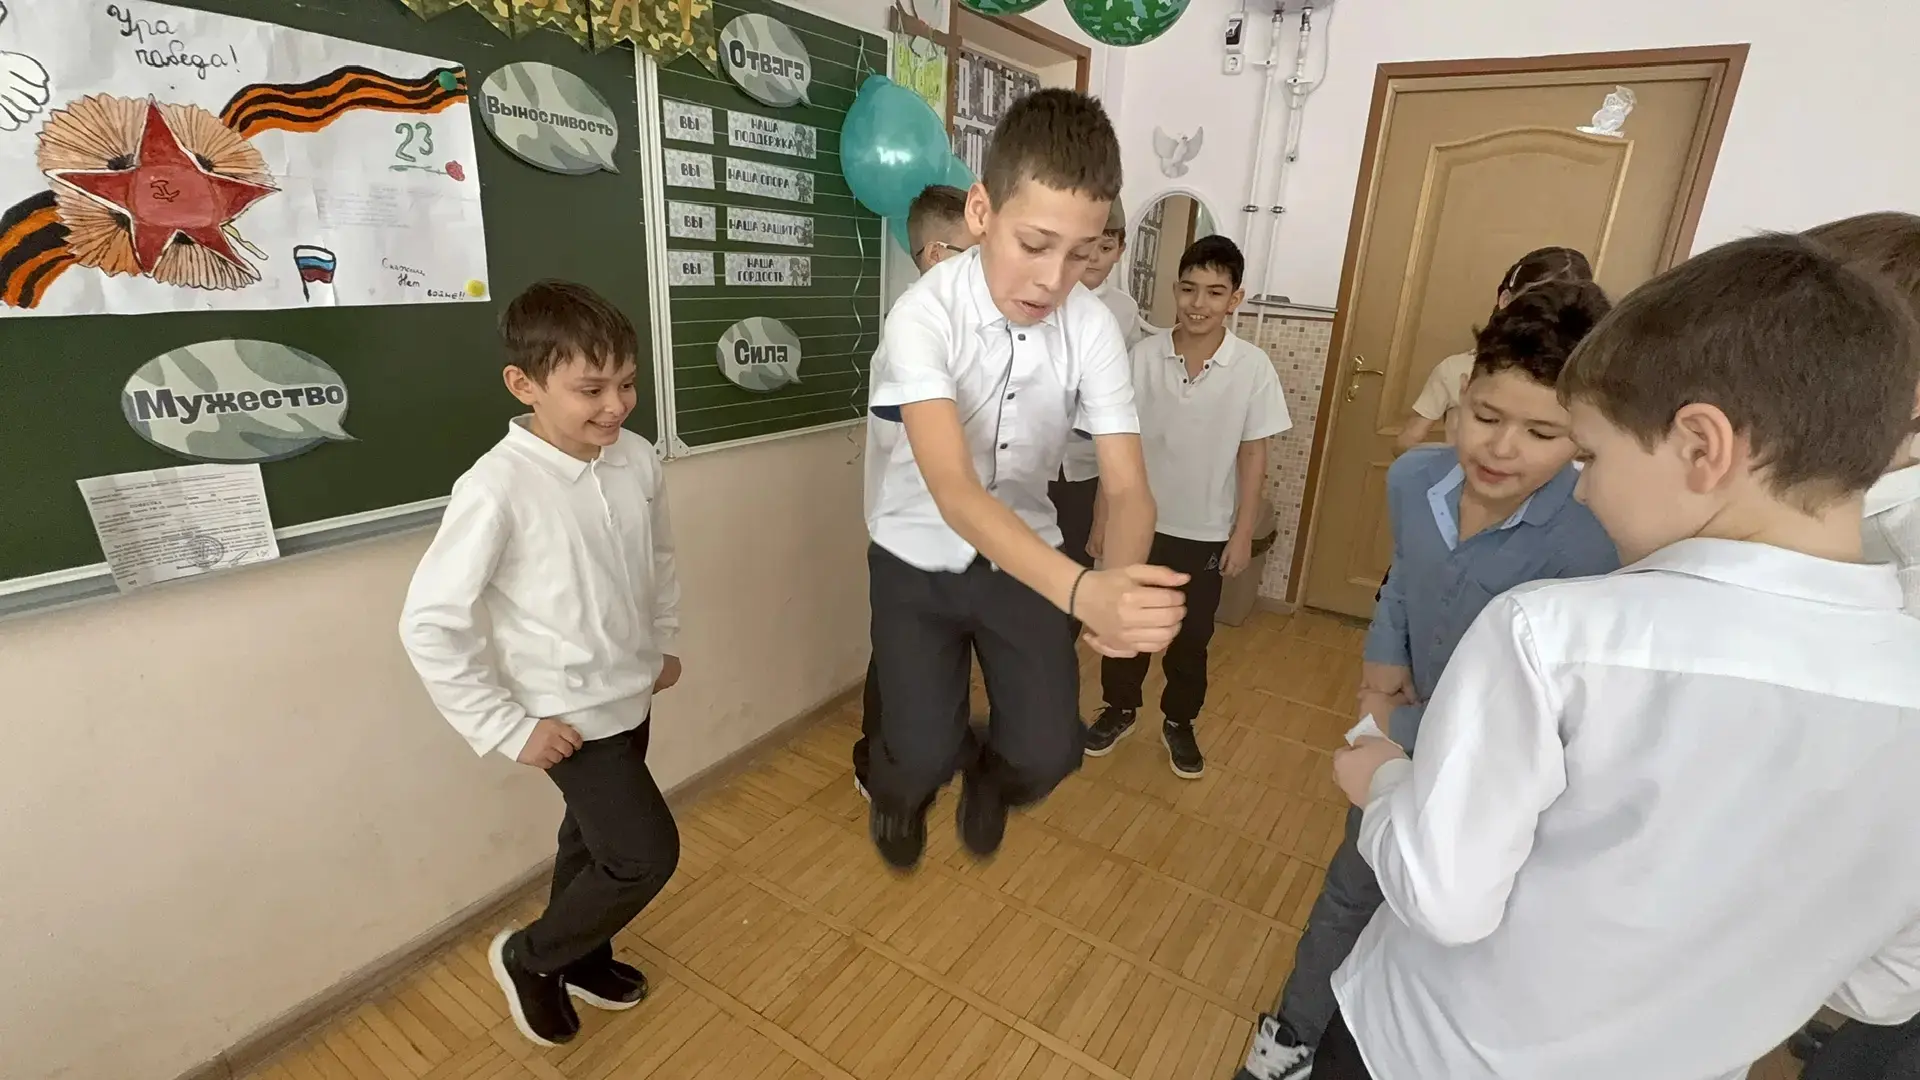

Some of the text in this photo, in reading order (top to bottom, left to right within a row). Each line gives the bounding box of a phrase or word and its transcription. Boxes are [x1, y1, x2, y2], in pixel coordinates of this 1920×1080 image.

[106, 4, 177, 44] Ура
[729, 39, 806, 82] Отвага
[486, 95, 615, 138] Выносливость
[679, 115, 700, 131] ВЫ
[751, 118, 779, 133] НАША
[395, 121, 434, 162] 23
[734, 129, 794, 149] ПОДДЕРЖКА
[680, 162, 701, 178] ВЫ
[728, 168, 790, 189] НАША ОПОРА
[684, 215, 703, 229] ВЫ
[729, 218, 799, 236] НАША ЗАЩИТА
[682, 262, 702, 275] ВЫ
[747, 258, 775, 269] НАША
[397, 273, 420, 288] Нет
[738, 270, 785, 283] ГОРДОСТЬ
[733, 339, 789, 366] Сила
[134, 384, 345, 424] Мужество
